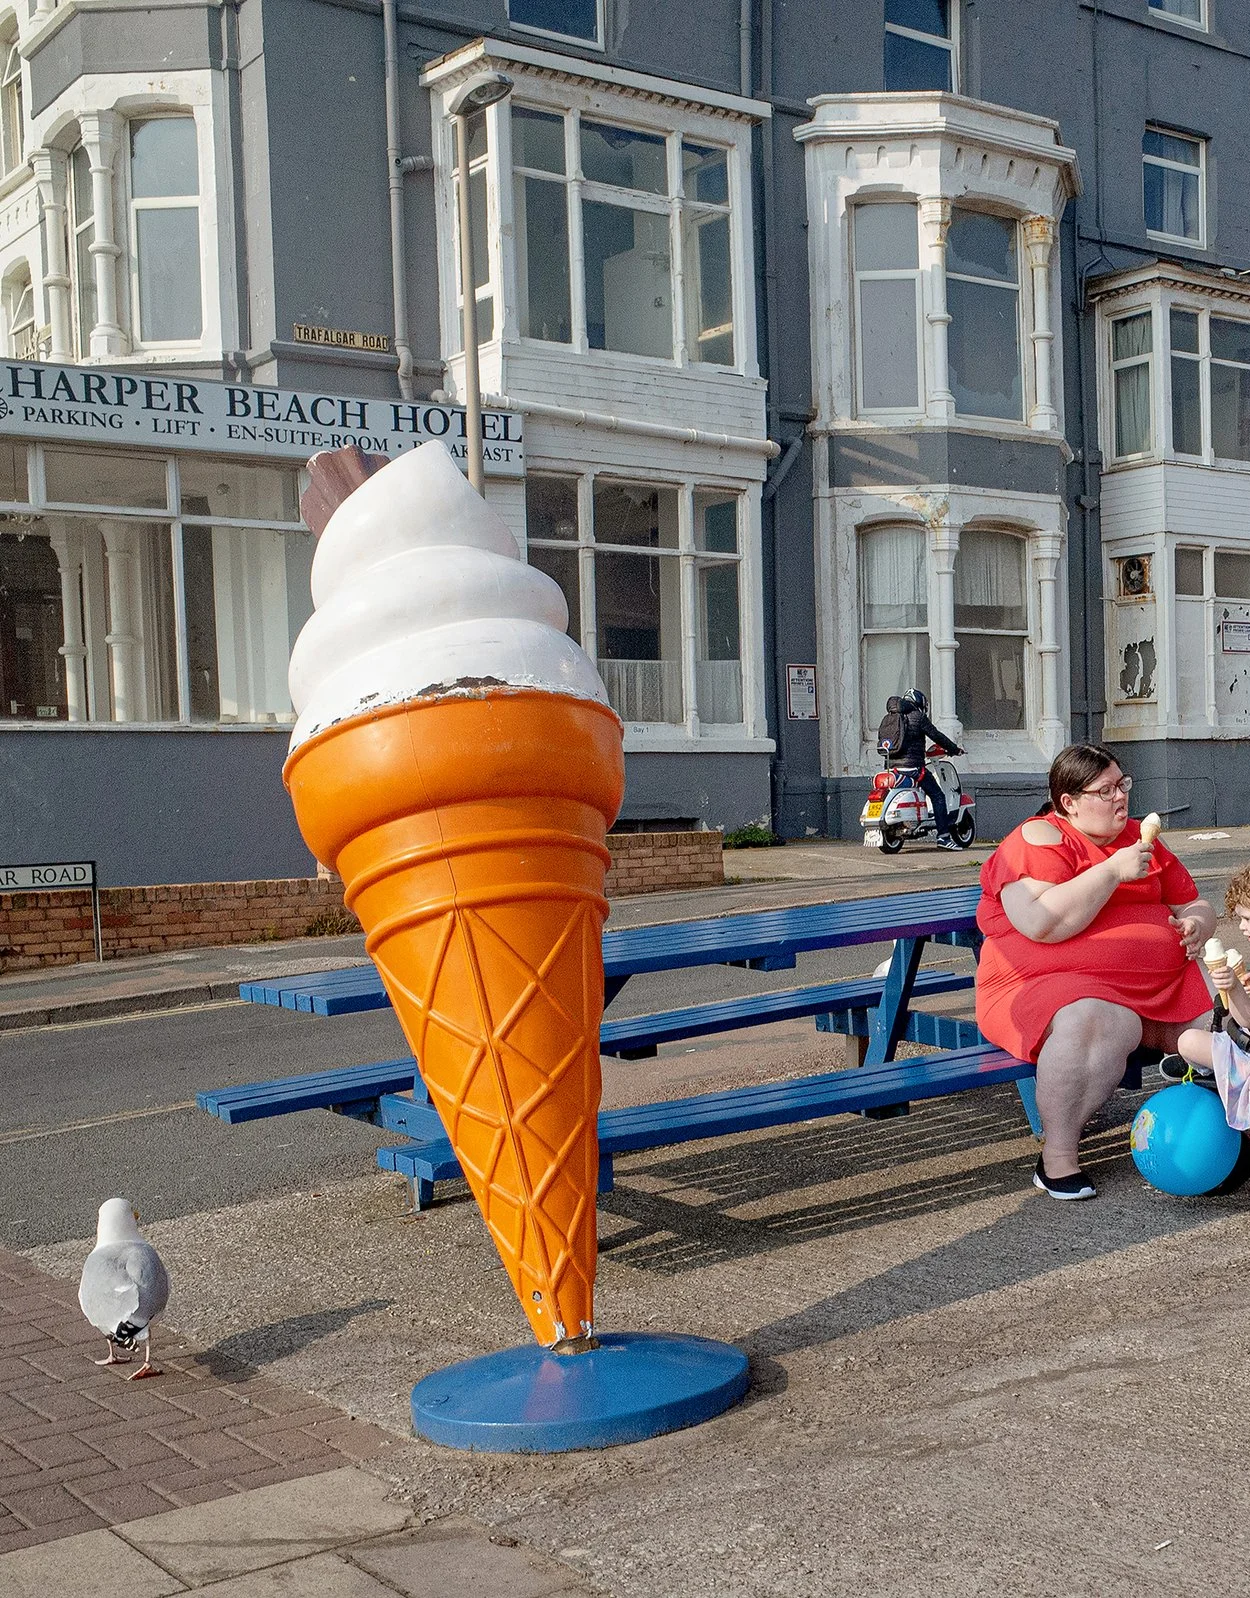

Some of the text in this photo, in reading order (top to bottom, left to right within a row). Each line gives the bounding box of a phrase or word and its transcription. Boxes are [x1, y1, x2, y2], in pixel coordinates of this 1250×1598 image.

[297, 326, 388, 349] TRAFALGAR ROAD
[6, 366, 522, 443] HARPER BEACH HOTEL
[22, 405, 124, 429] PARKING
[152, 418, 200, 436] LIFT
[227, 424, 388, 452] EN-SUITE-ROOM
[31, 867, 87, 884] ROAD
